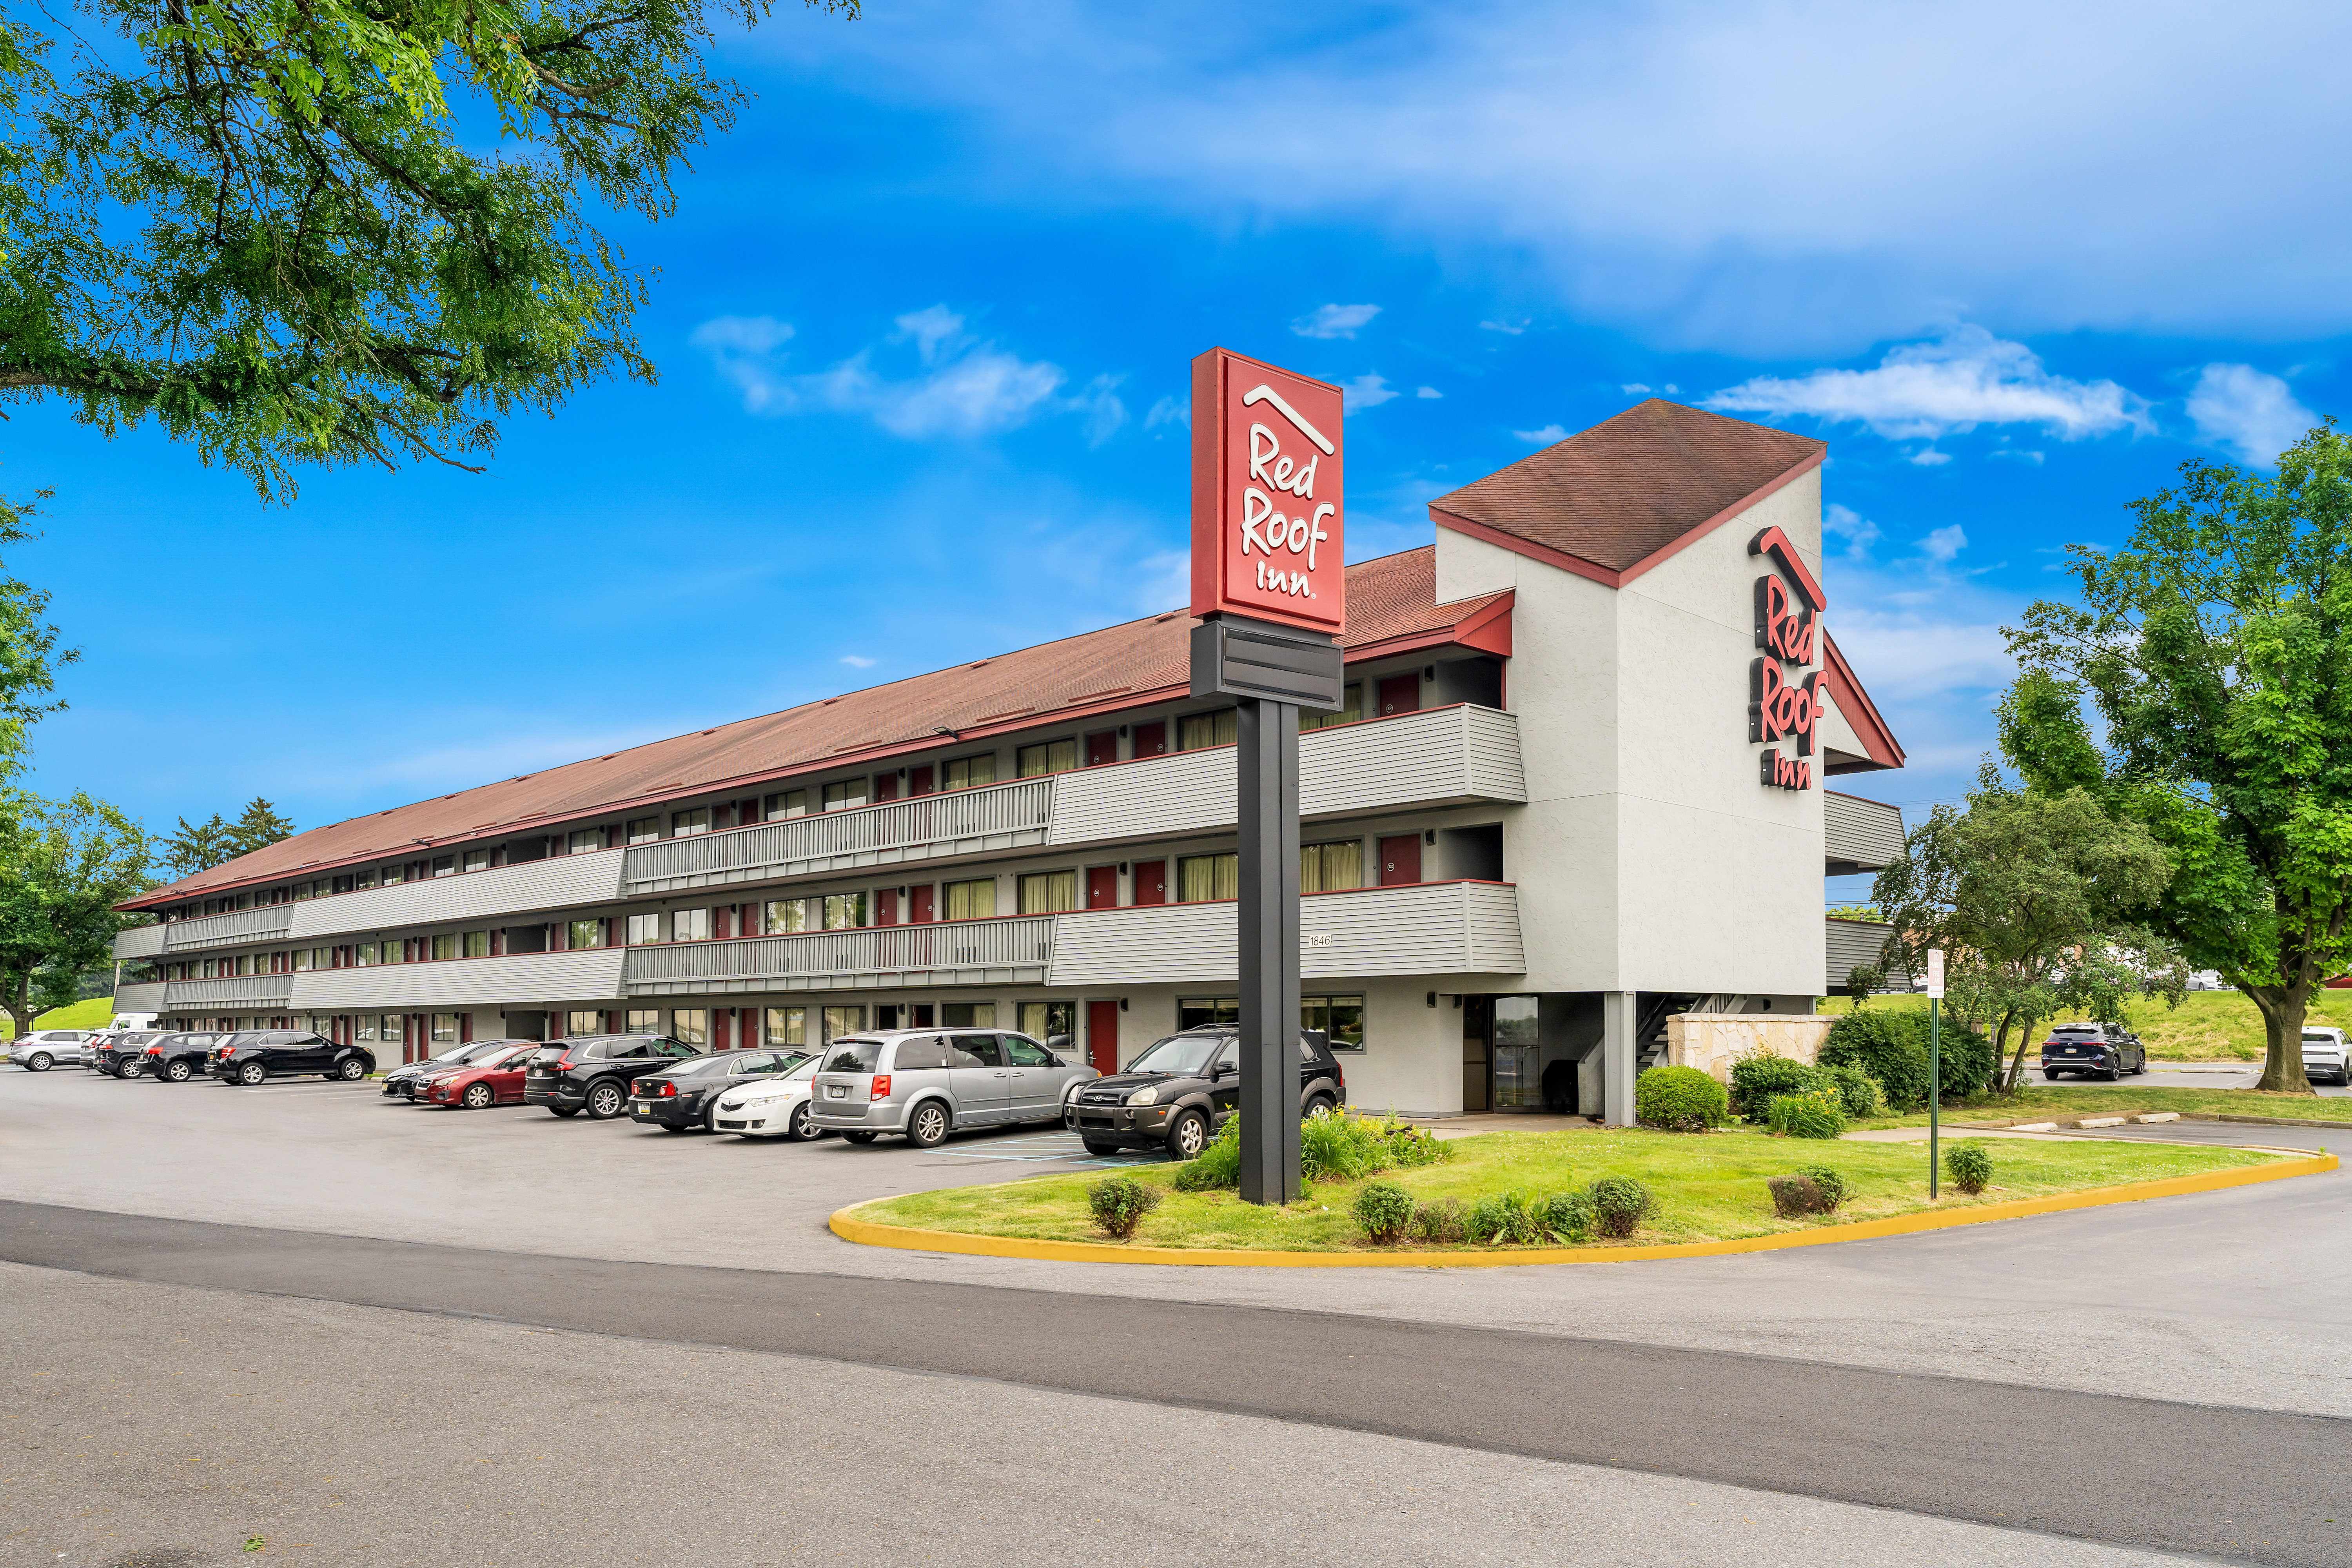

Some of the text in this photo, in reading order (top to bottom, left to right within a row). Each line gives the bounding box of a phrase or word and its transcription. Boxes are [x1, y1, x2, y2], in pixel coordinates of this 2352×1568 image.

[1249, 422, 1318, 499] Red
[1241, 486, 1335, 571] Roof
[1767, 574, 1816, 666] Red
[1760, 656, 1829, 756] Roof
[1773, 748, 1811, 791] Inn
[1310, 935, 1330, 946] 1846
